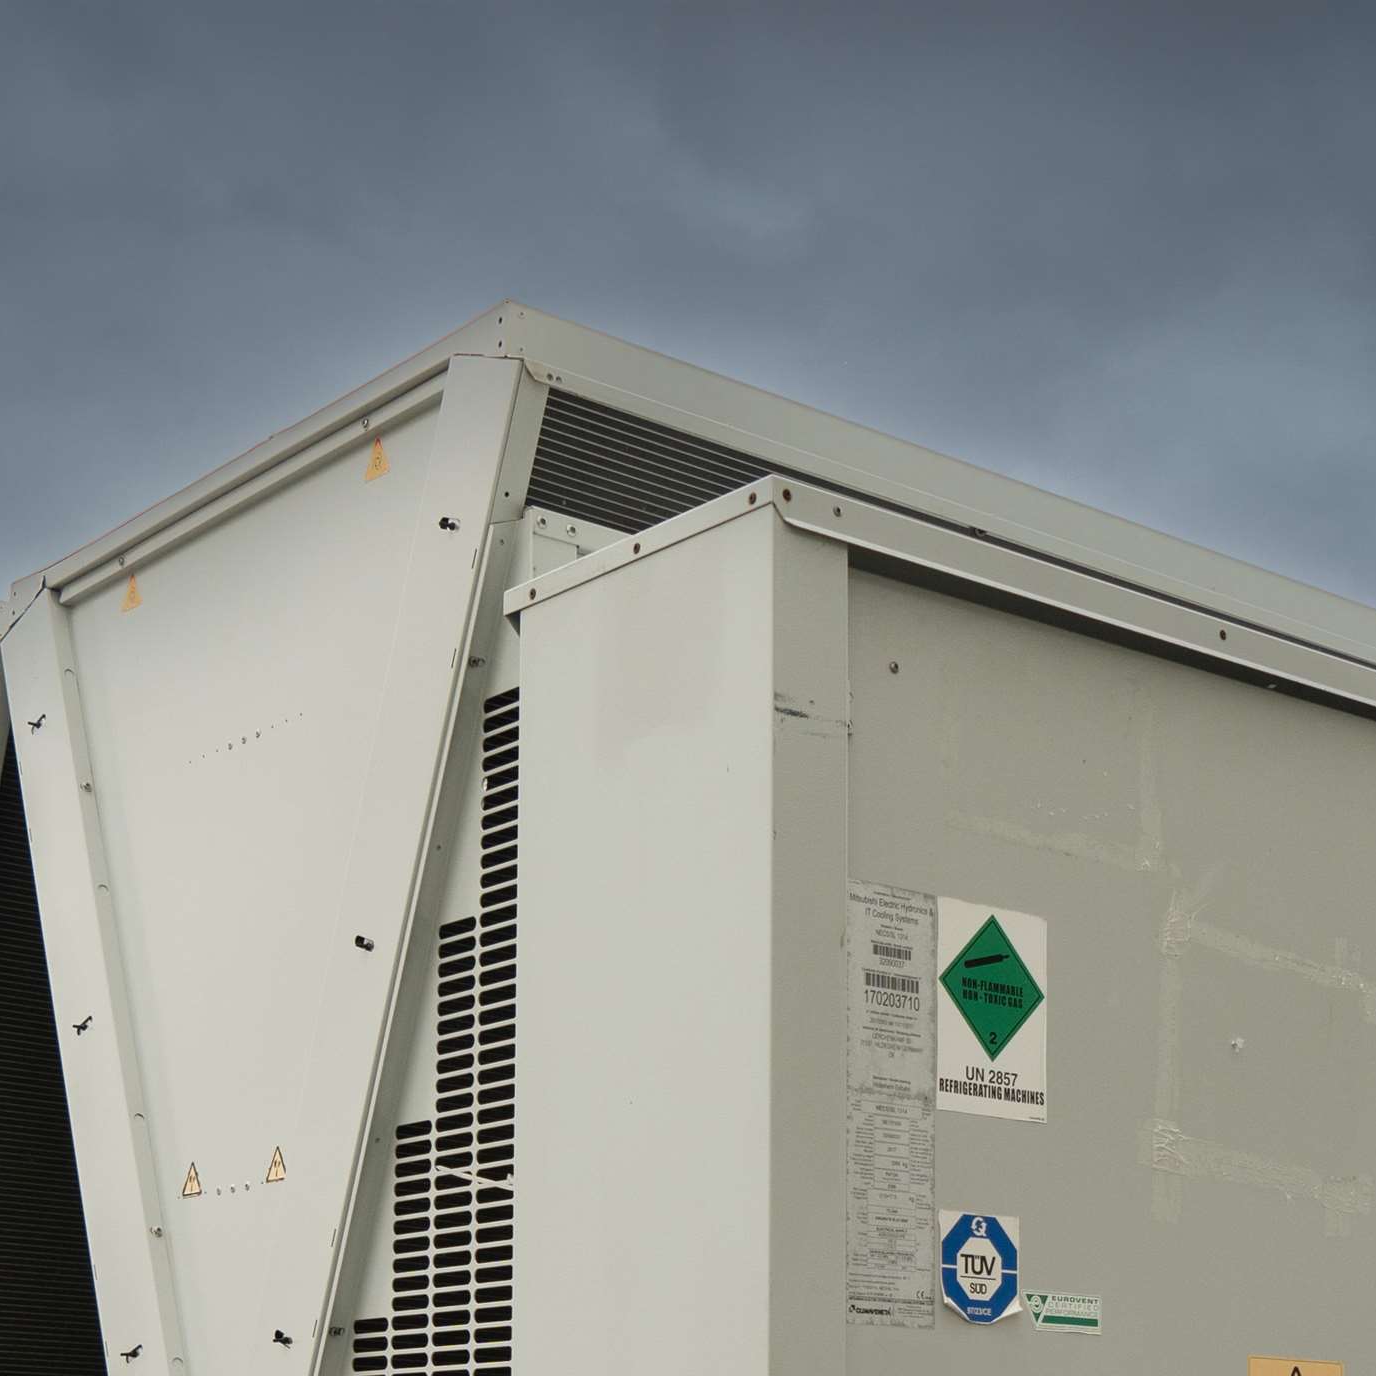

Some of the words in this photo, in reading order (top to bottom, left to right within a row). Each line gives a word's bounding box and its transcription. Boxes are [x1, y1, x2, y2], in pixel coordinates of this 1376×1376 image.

[878, 898, 900, 910] Electric
[872, 908, 894, 922] Cooling
[962, 976, 1023, 998] NON-FLAMMABLE
[864, 990, 921, 1012] 170203710
[1007, 996, 1023, 1009] GAS
[989, 1031, 998, 1045] 2
[965, 1066, 985, 1082] UN
[989, 1069, 1019, 1088] 2857
[939, 1077, 1003, 1101] REFRIGERATING
[1003, 1087, 1045, 1106] MACHINES
[959, 1253, 996, 1276] TÜV
[969, 1281, 988, 1295] SÜD
[1047, 1301, 1100, 1312] CERTIFIED
[1051, 1295, 1099, 1305] EUROVENT
